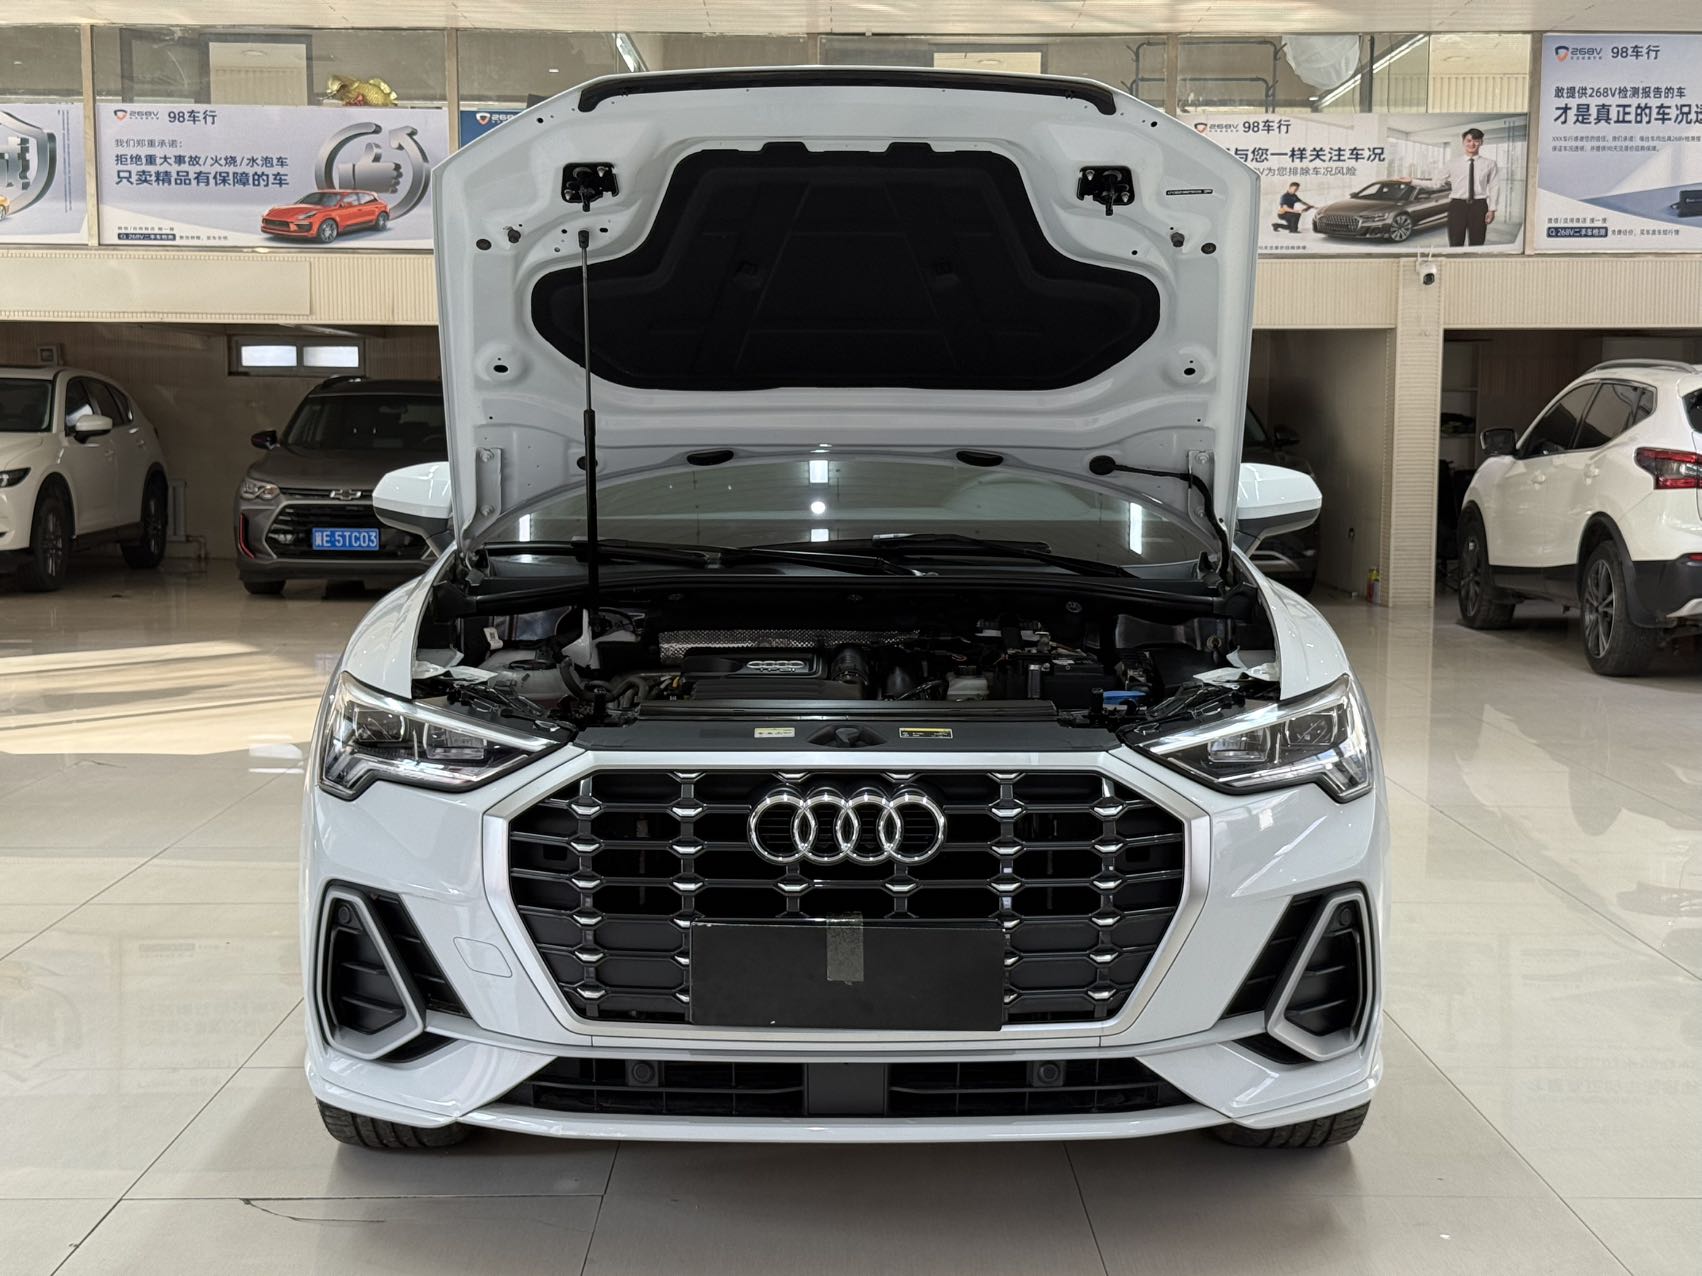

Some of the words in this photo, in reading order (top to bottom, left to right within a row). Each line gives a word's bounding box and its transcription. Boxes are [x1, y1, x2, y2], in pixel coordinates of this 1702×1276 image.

[1610, 44, 1661, 60] 98车行
[1553, 86, 1686, 99] 敢提供268V检测报告的车
[168, 109, 217, 125] 98车行
[1242, 118, 1291, 134] 98车行
[114, 153, 289, 168] 拒绝重大事故/火烧/水泡车
[1226, 146, 1386, 164] 与您一样关注车况
[115, 169, 290, 188] 只卖精品有保障的车
[1256, 166, 1357, 177] V为您排除车况风险
